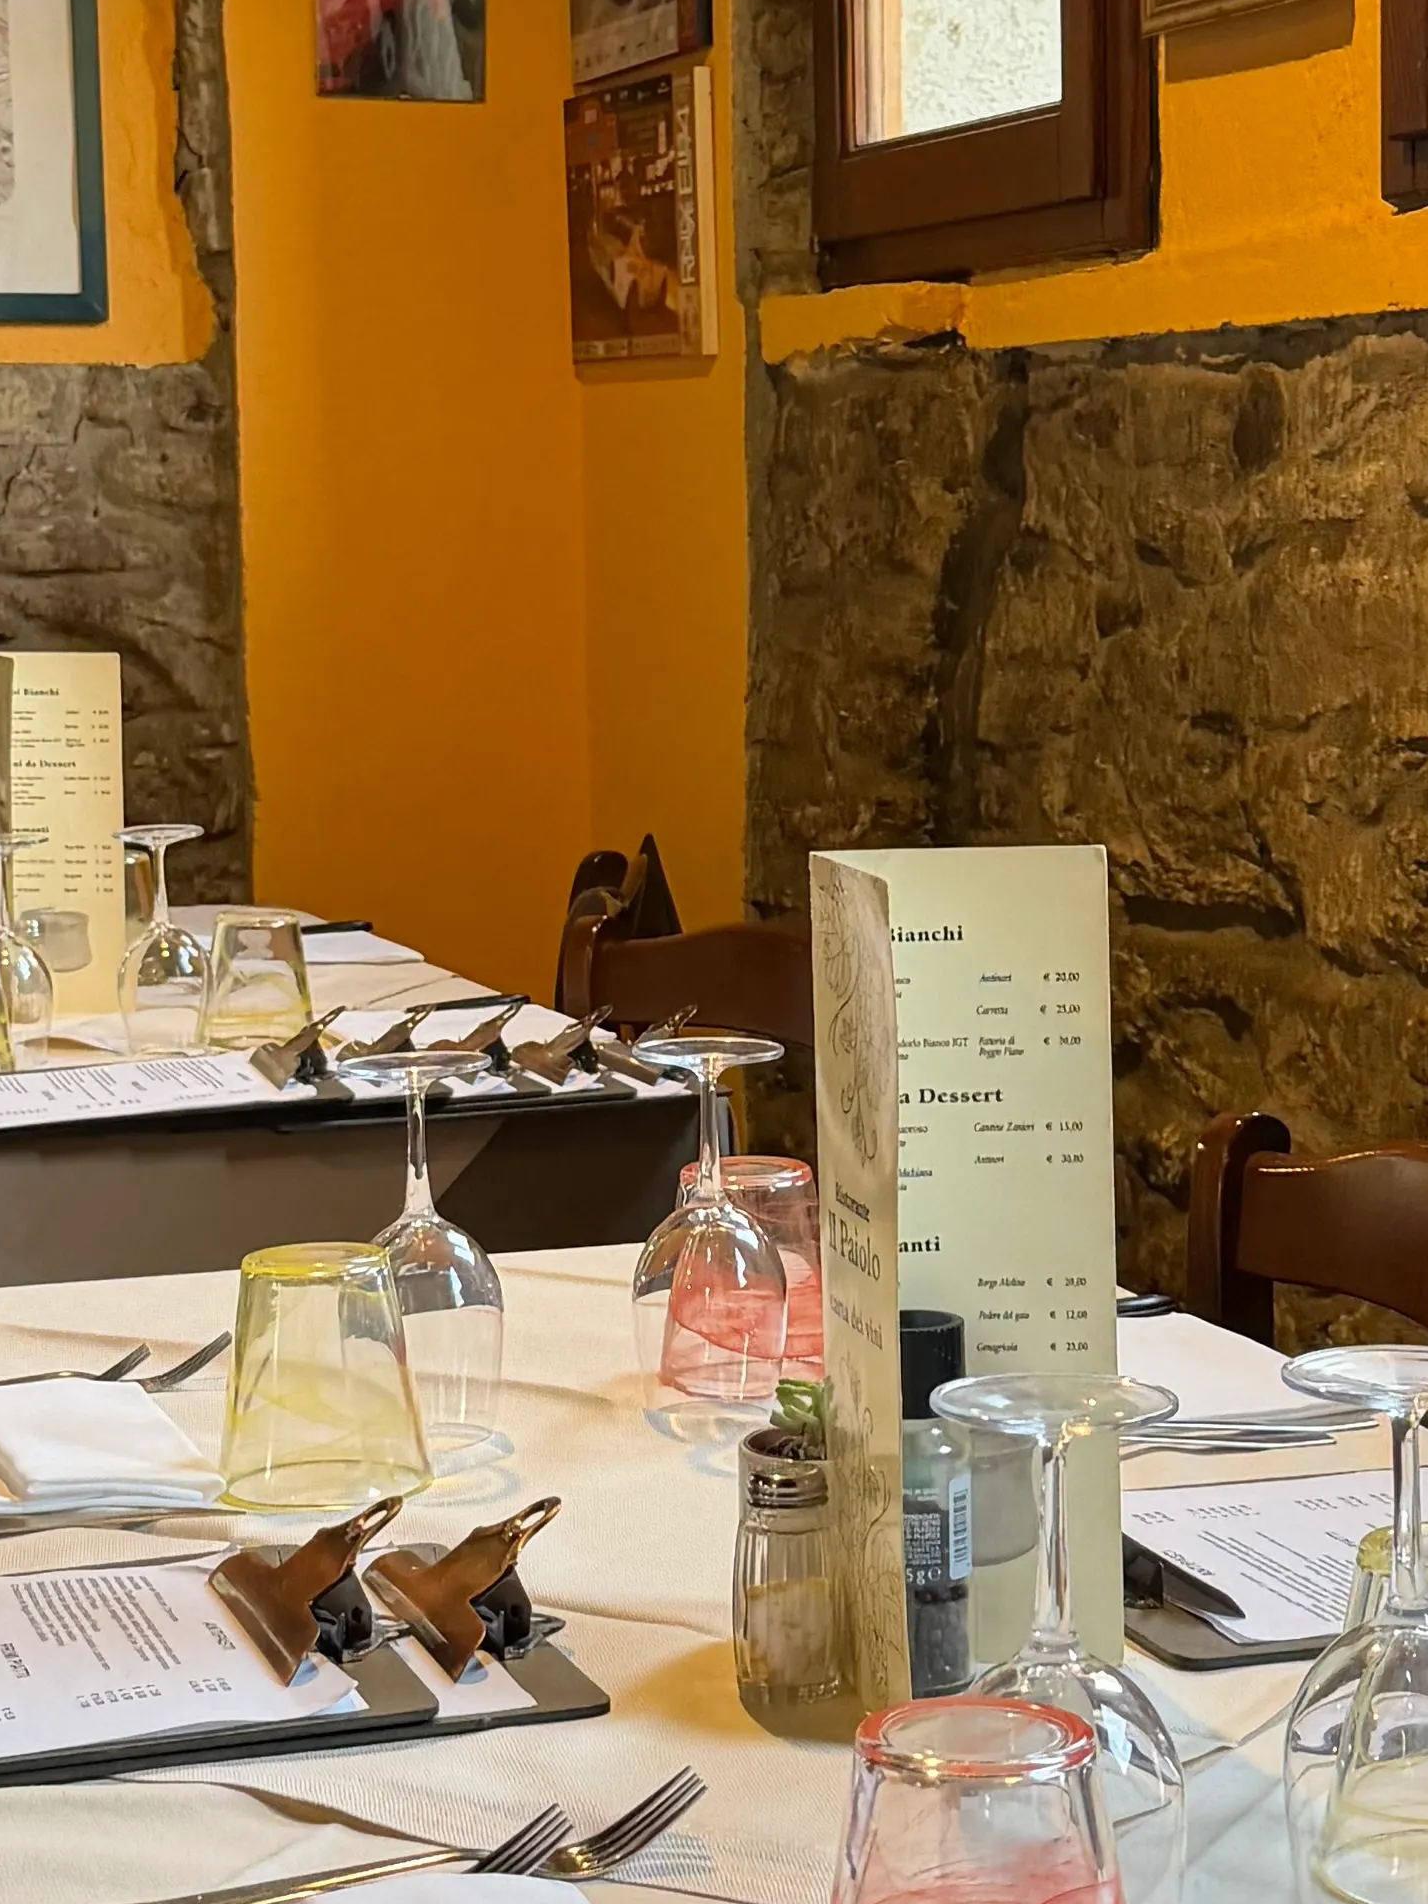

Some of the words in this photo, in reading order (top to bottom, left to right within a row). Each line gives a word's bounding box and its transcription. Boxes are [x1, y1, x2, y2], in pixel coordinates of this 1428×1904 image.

[24, 687, 59, 696] Bianchi
[40, 760, 77, 768] Dessert
[919, 1087, 1004, 1104] Dessert
[828, 1208, 837, 1251] Il
[840, 1218, 881, 1282] Paiolo
[829, 1292, 849, 1324] carta
[851, 1303, 864, 1335] dei
[865, 1318, 883, 1350] vini
